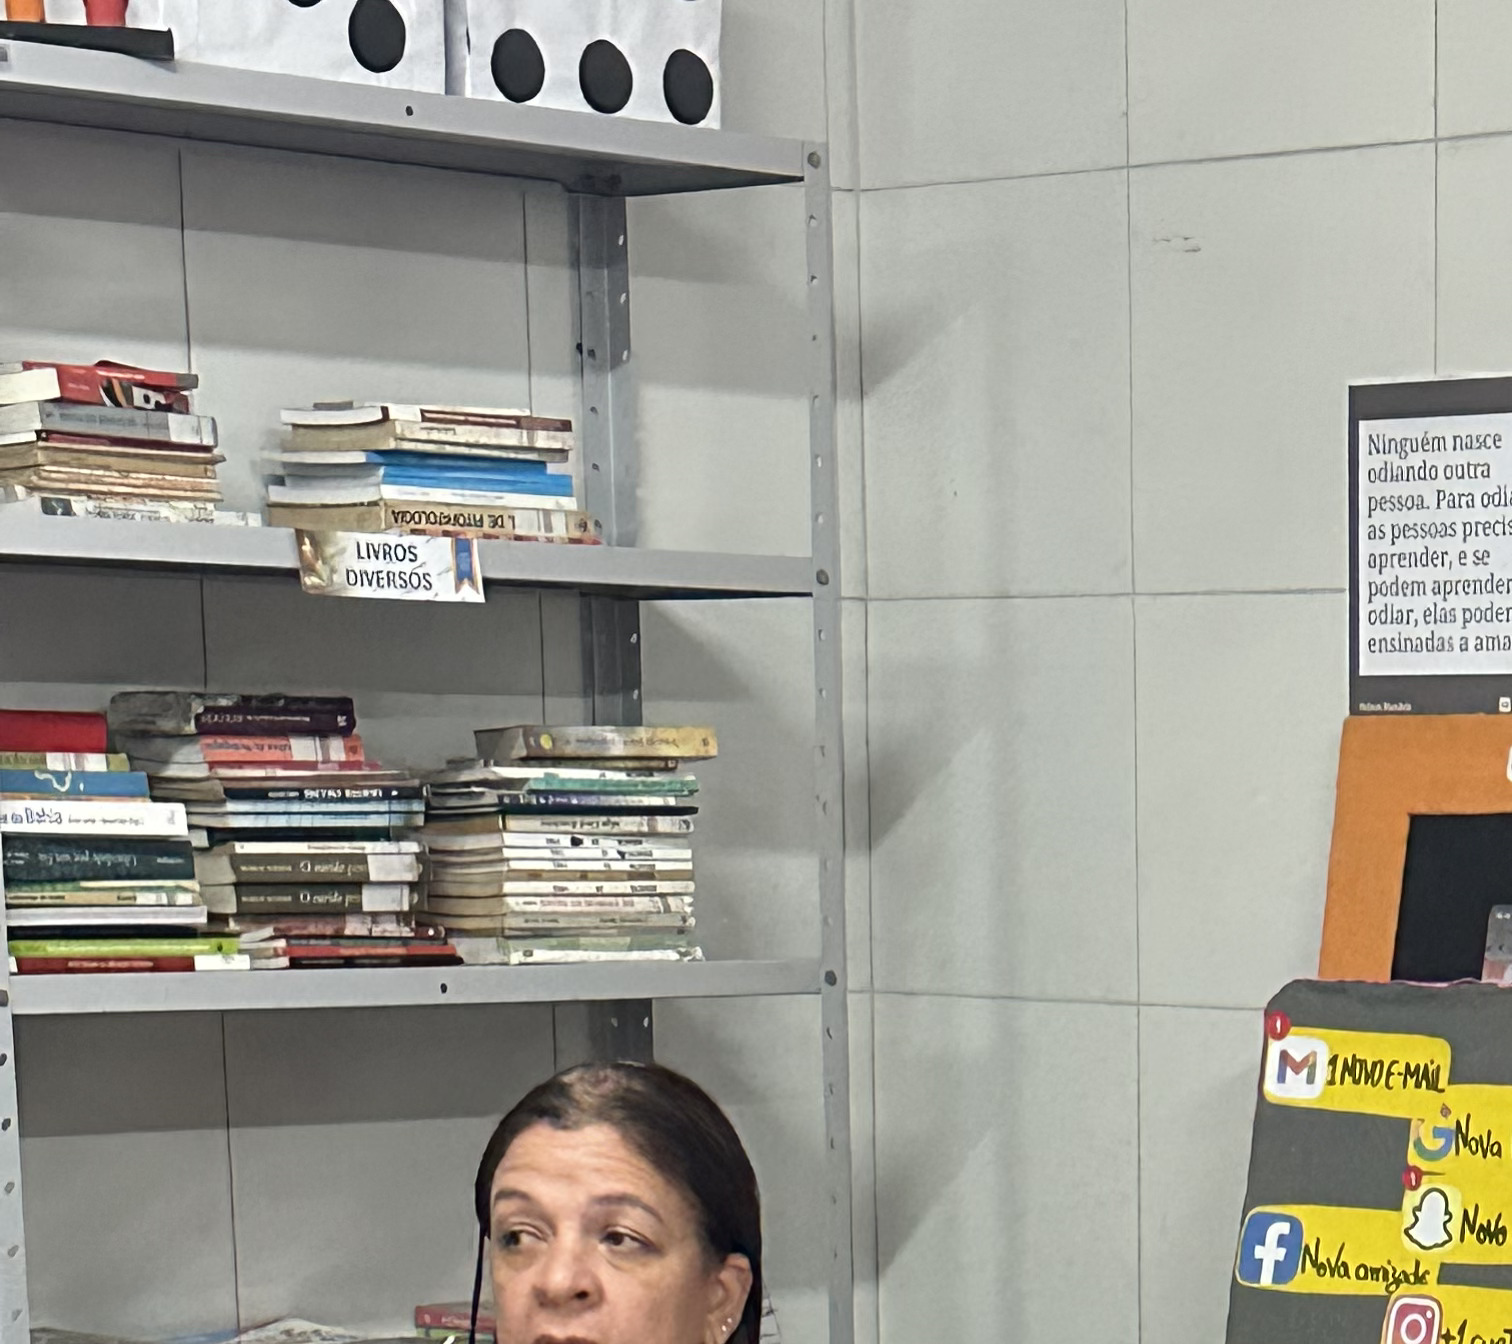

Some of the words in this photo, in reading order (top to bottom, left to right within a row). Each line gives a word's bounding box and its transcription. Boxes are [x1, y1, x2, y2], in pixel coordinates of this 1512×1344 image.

[1367, 431, 1447, 459] Ninguém
[1452, 432, 1503, 451] nasce
[1367, 460, 1439, 484] odiando
[1443, 461, 1491, 481] outra
[1367, 493, 1430, 517] pessoa.
[1435, 489, 1476, 510] Para
[1367, 524, 1386, 541] as
[1390, 521, 1458, 545] pessoas
[356, 541, 418, 563] LIVROS
[1367, 549, 1453, 574] aprender,
[1458, 551, 1468, 567] e
[1472, 549, 1491, 567] se
[345, 567, 433, 591] DIVERSOS
[1367, 577, 1428, 604] podem
[1367, 605, 1419, 630] odiar,
[1423, 603, 1457, 624] elas
[1367, 632, 1455, 654] ensinadas
[1459, 634, 1469, 652] a
[1340, 1053, 1385, 1088] NOVO
[1455, 1114, 1502, 1159] Nova
[1460, 1204, 1507, 1246] Novo
[1301, 1238, 1350, 1280] Nova
